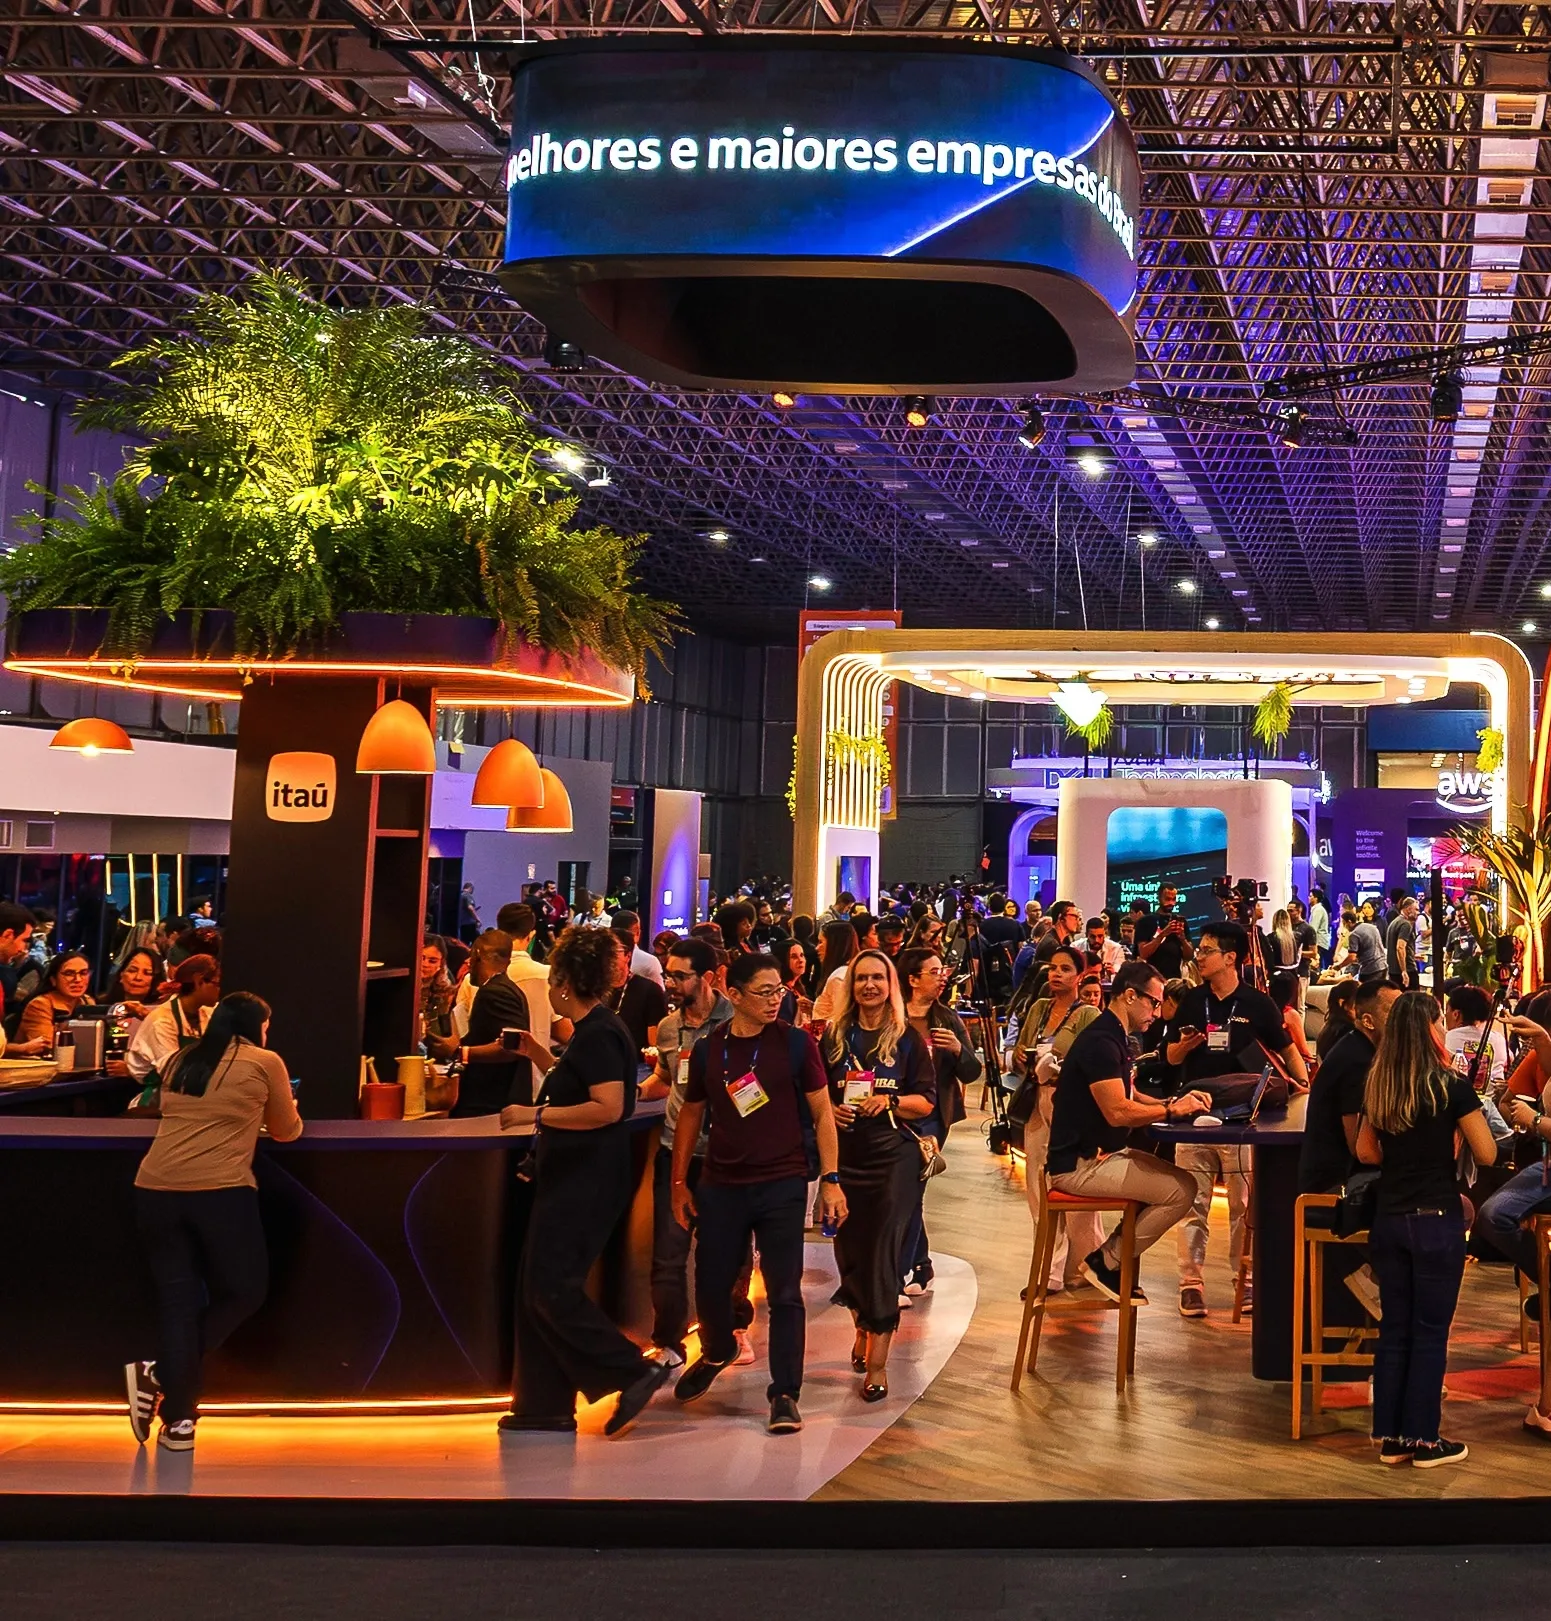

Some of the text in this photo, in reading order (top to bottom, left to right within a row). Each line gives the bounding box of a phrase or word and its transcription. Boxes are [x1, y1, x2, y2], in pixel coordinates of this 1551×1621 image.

[670, 136, 699, 169] e
[708, 126, 898, 172] maiores
[907, 139, 1097, 204] empresas
[272, 780, 329, 808] itaú
[1121, 882, 1143, 892] Uma
